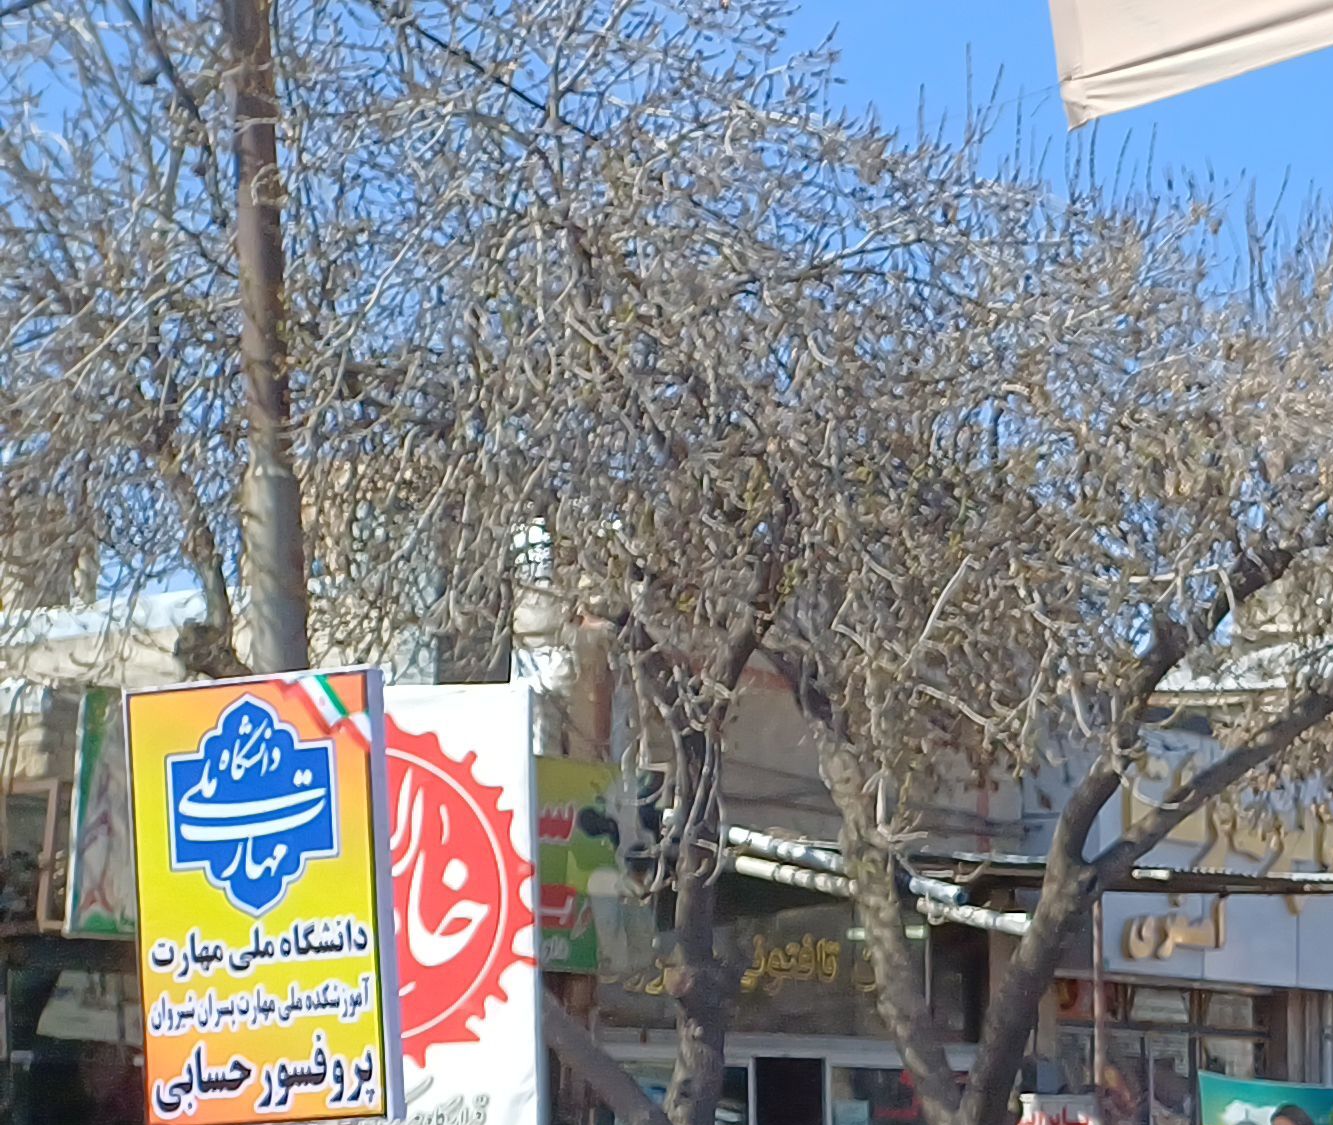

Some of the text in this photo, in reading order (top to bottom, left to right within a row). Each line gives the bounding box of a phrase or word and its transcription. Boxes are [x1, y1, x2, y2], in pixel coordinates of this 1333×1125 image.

[152, 920, 369, 978] دانشگاه ملی مهارت
[151, 977, 371, 1030] آموزشکده ملی مهارت پسران شیروان
[156, 1034, 375, 1112] پروفسور حسابی
